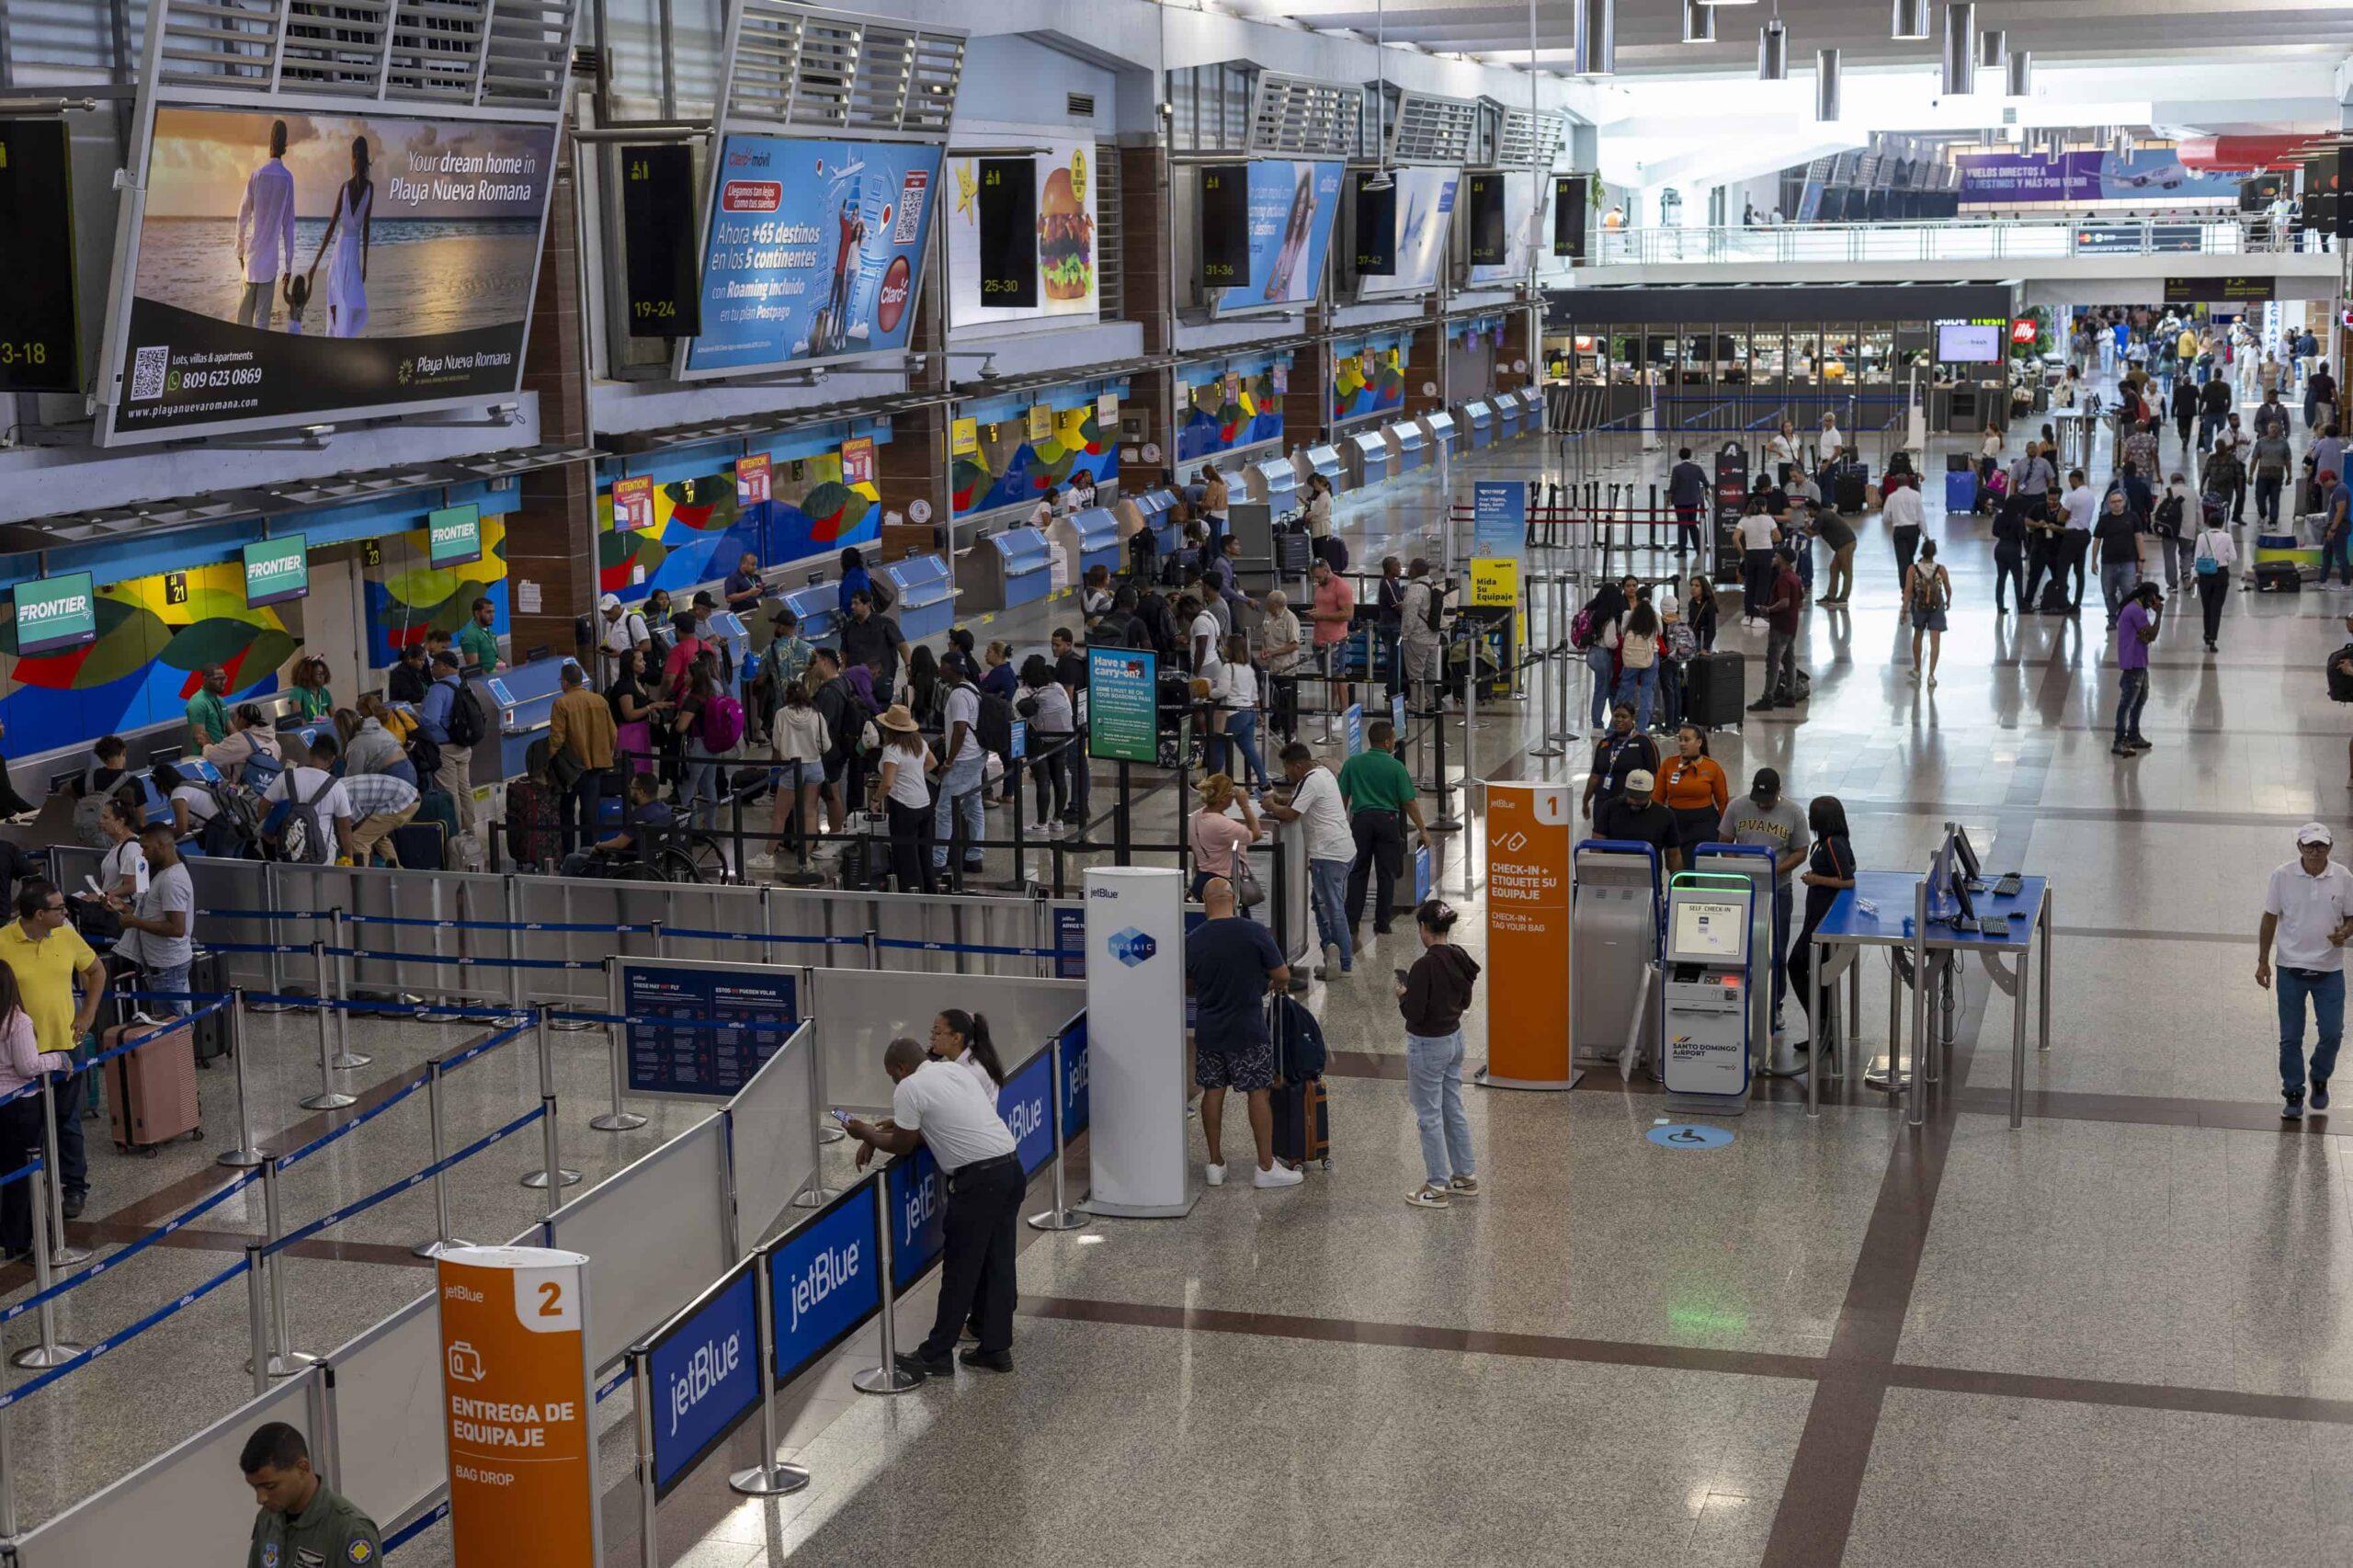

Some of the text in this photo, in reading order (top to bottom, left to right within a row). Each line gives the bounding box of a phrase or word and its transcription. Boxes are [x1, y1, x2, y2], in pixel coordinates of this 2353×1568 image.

[409, 151, 535, 174] Your dream home in
[1967, 166, 2047, 178] VUELOS DIRECTOS A
[389, 177, 531, 206] Playa Nueva Romana
[2017, 178, 2024, 188] Y
[2044, 177, 2061, 187] POR
[728, 186, 775, 199] Llegamos tan lejos
[757, 199, 776, 209] sueños
[717, 222, 821, 244] Ahora +65 destinos
[711, 246, 817, 270] en los 5 continentes
[1358, 256, 1382, 266] 37-42
[1206, 265, 1233, 276] 31-36
[712, 278, 805, 301] con Roaming incluido
[881, 281, 905, 304] Claro
[984, 279, 1018, 292] 25-30
[634, 301, 676, 317] 19-24
[720, 305, 790, 323] en tu plan Postpago
[2015, 322, 2035, 341] illy
[173, 350, 253, 366] Lots, villas & apartments
[416, 352, 511, 376] Playa Nueva Romana
[183, 368, 262, 389] 809 623 0869
[128, 398, 258, 418] www.playanuevaromana.com
[740, 456, 767, 470] ATTENTION!
[618, 478, 649, 493] ATTENTION!
[432, 523, 475, 542] FRONTIER
[247, 554, 301, 578] FRONTIER
[369, 551, 380, 565] 23
[1476, 578, 1496, 586] Mida
[174, 585, 185, 603] 21
[1477, 593, 1513, 602] Equipaje
[19, 595, 86, 622] FRONTIER
[1094, 656, 1126, 668] Have a
[1095, 666, 1141, 679] carry-on?
[1110, 692, 1137, 700] BOARDING
[1491, 799, 1515, 809] jetBlue
[1547, 797, 1557, 816] 1
[1737, 818, 1789, 839] PVAMU
[1492, 862, 1540, 875] CHECK-IN
[1492, 875, 1557, 888] ETIQUETE SU
[1090, 888, 1118, 899] jetBlue
[1492, 887, 1540, 900] EQUIPAJE
[1492, 912, 1527, 921] CHECK-IN
[1492, 921, 1545, 932] TAG YOUR BAG
[1069, 1048, 1089, 1107] jetB
[1008, 1097, 1042, 1144] tBlue
[445, 1283, 483, 1302] jetBlue
[791, 1239, 859, 1333] jetBlue
[538, 1282, 563, 1316] 2
[671, 1330, 739, 1437] jetBlue
[452, 1395, 574, 1423] ENTREGA DE
[454, 1421, 545, 1448] EQUIPAJE
[456, 1464, 515, 1486] BAG DROP
